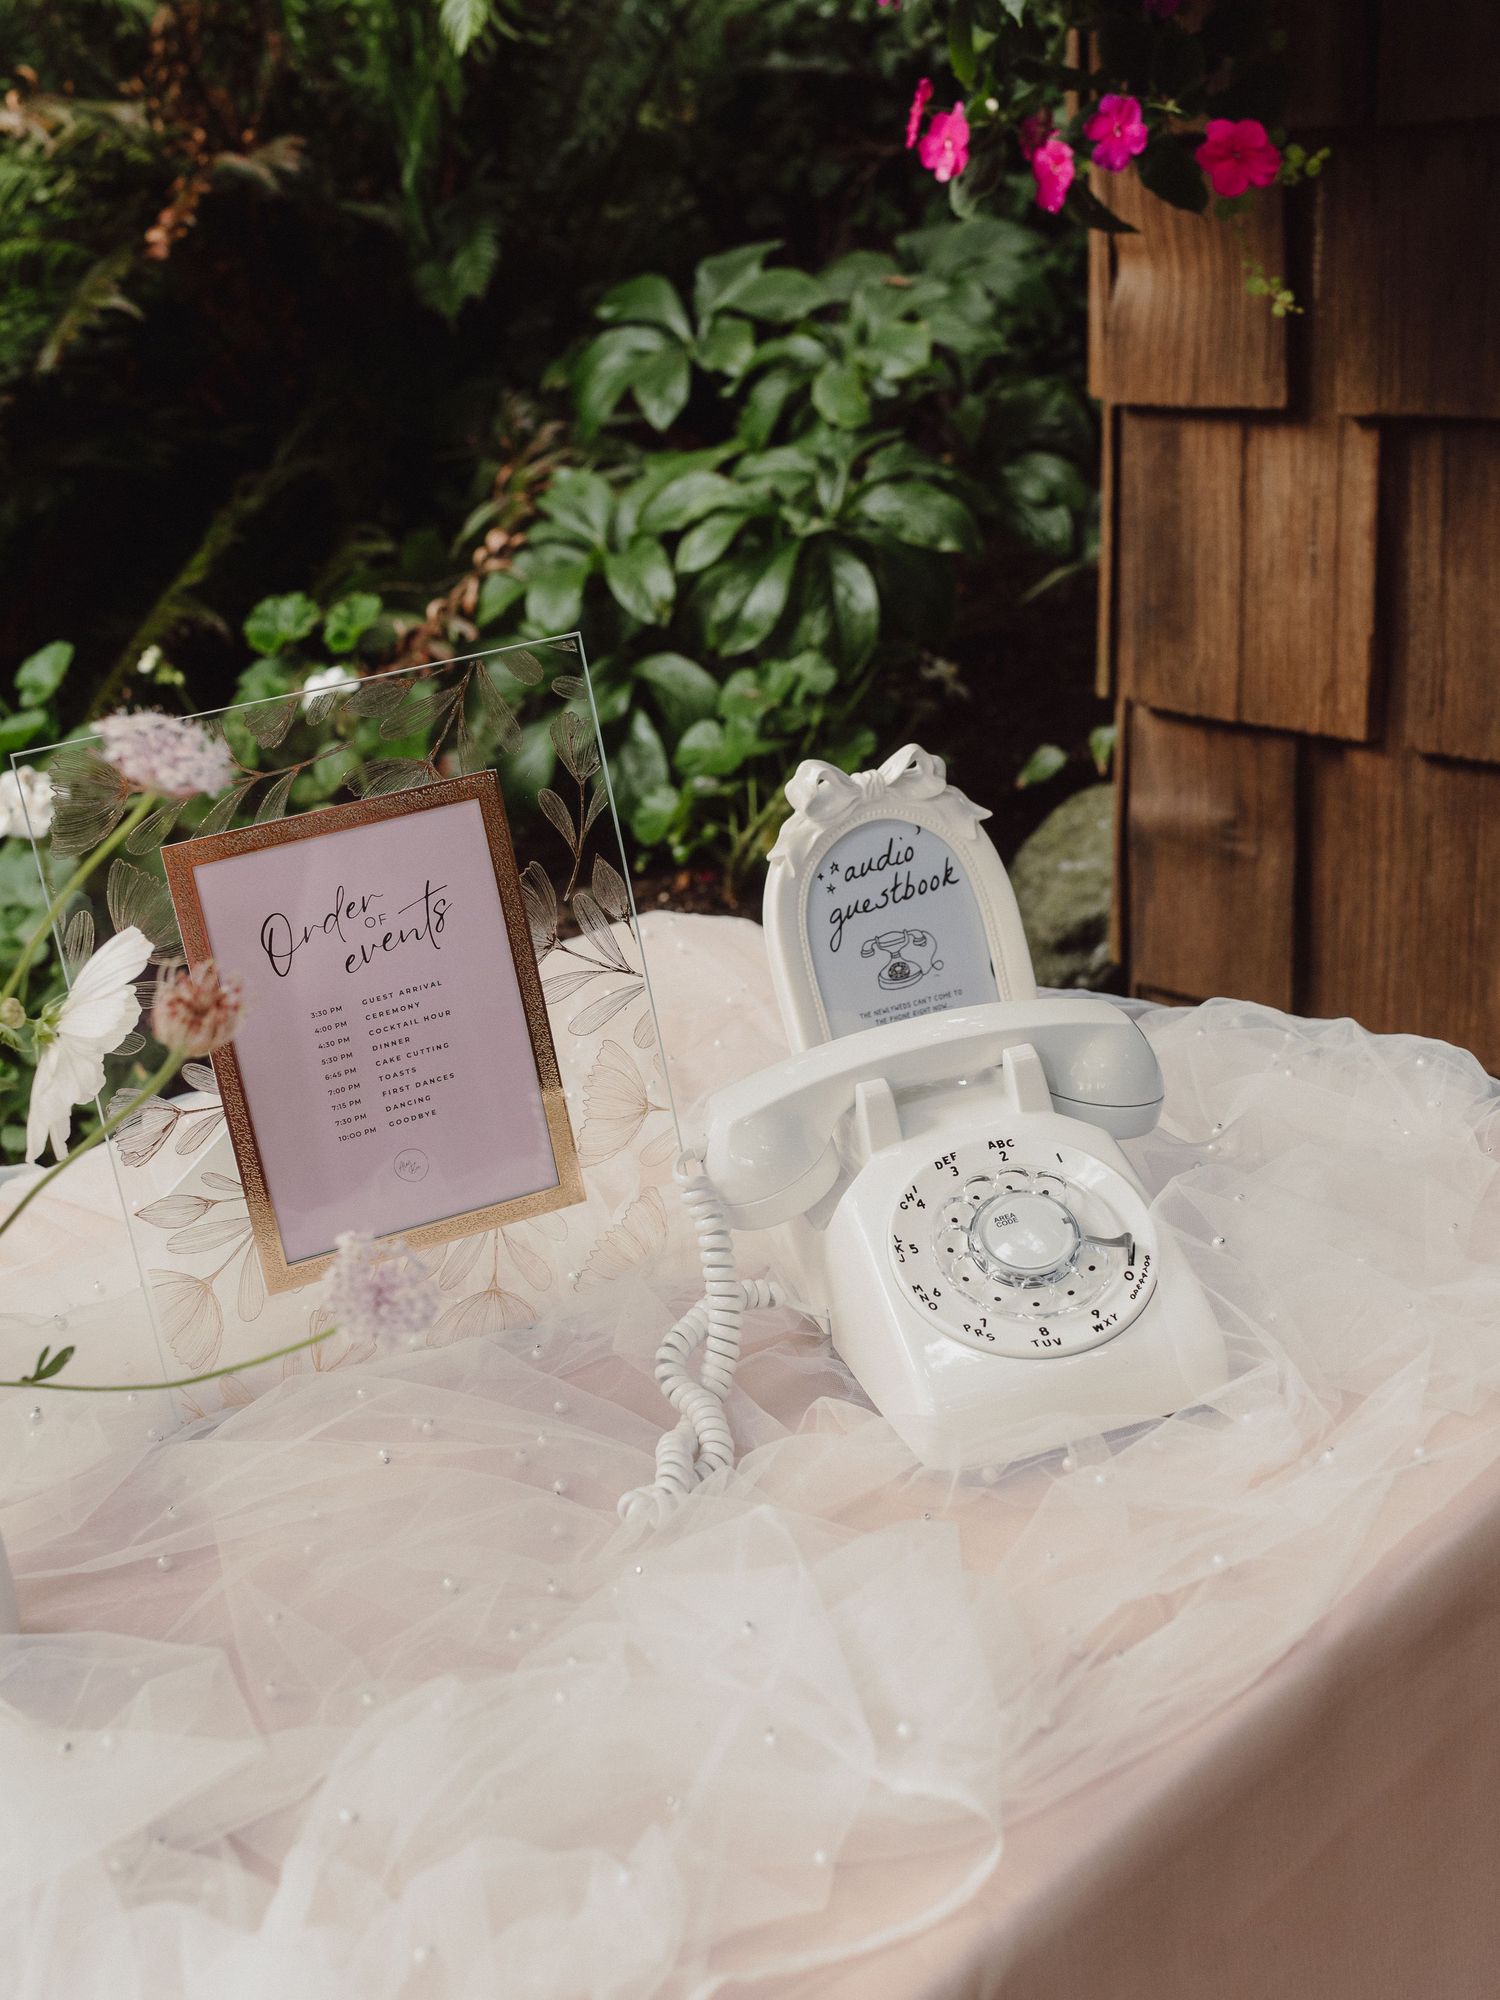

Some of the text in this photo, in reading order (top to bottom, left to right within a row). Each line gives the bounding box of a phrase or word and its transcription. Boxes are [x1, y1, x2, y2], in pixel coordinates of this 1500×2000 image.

[845, 837, 914, 882] audio
[829, 857, 960, 952] guestbook
[260, 885, 384, 977] Order
[345, 880, 453, 973] events
[364, 913, 387, 928] OF
[311, 980, 443, 1019] 3:30 PM GUEST ARRIVAL
[860, 1011, 872, 1019] THE
[934, 992, 952, 1001] COME
[314, 1001, 421, 1034] 4:00 PM CEREMONY
[318, 1009, 451, 1049] 4:30 PM COCKTAIL HOUR
[321, 1036, 411, 1065] 5:30 PM DINNER
[325, 1042, 450, 1080] 6:45 PM CAKE CUTTING
[328, 1067, 417, 1096] 7:00 PM TOASTS
[331, 1072, 455, 1111] 7:15 PM FIRST DANCES
[335, 1095, 431, 1127] 7:30 PM DANCING
[338, 1109, 437, 1142] 10:00 PM GOODBYE
[988, 1139, 1015, 1150] ABC
[934, 1152, 958, 1170] DEF
[999, 1151, 1009, 1162] 2
[1056, 1153, 1063, 1164] 1
[950, 1166, 959, 1177] 3
[899, 1185, 918, 1210] GHI
[916, 1199, 926, 1209] 4
[994, 1212, 1016, 1224] AREA
[996, 1218, 1019, 1228] CODE
[909, 1244, 919, 1255] 5
[1129, 1254, 1151, 1300] OPERATOR
[912, 1284, 938, 1311] MNO
[932, 1287, 942, 1298] 6
[979, 1317, 987, 1328] 7
[1091, 1309, 1100, 1319] 9
[1092, 1313, 1118, 1332] WXY
[963, 1323, 996, 1342] PRS
[1030, 1337, 1063, 1348] TUV
[1039, 1326, 1050, 1337] 8
